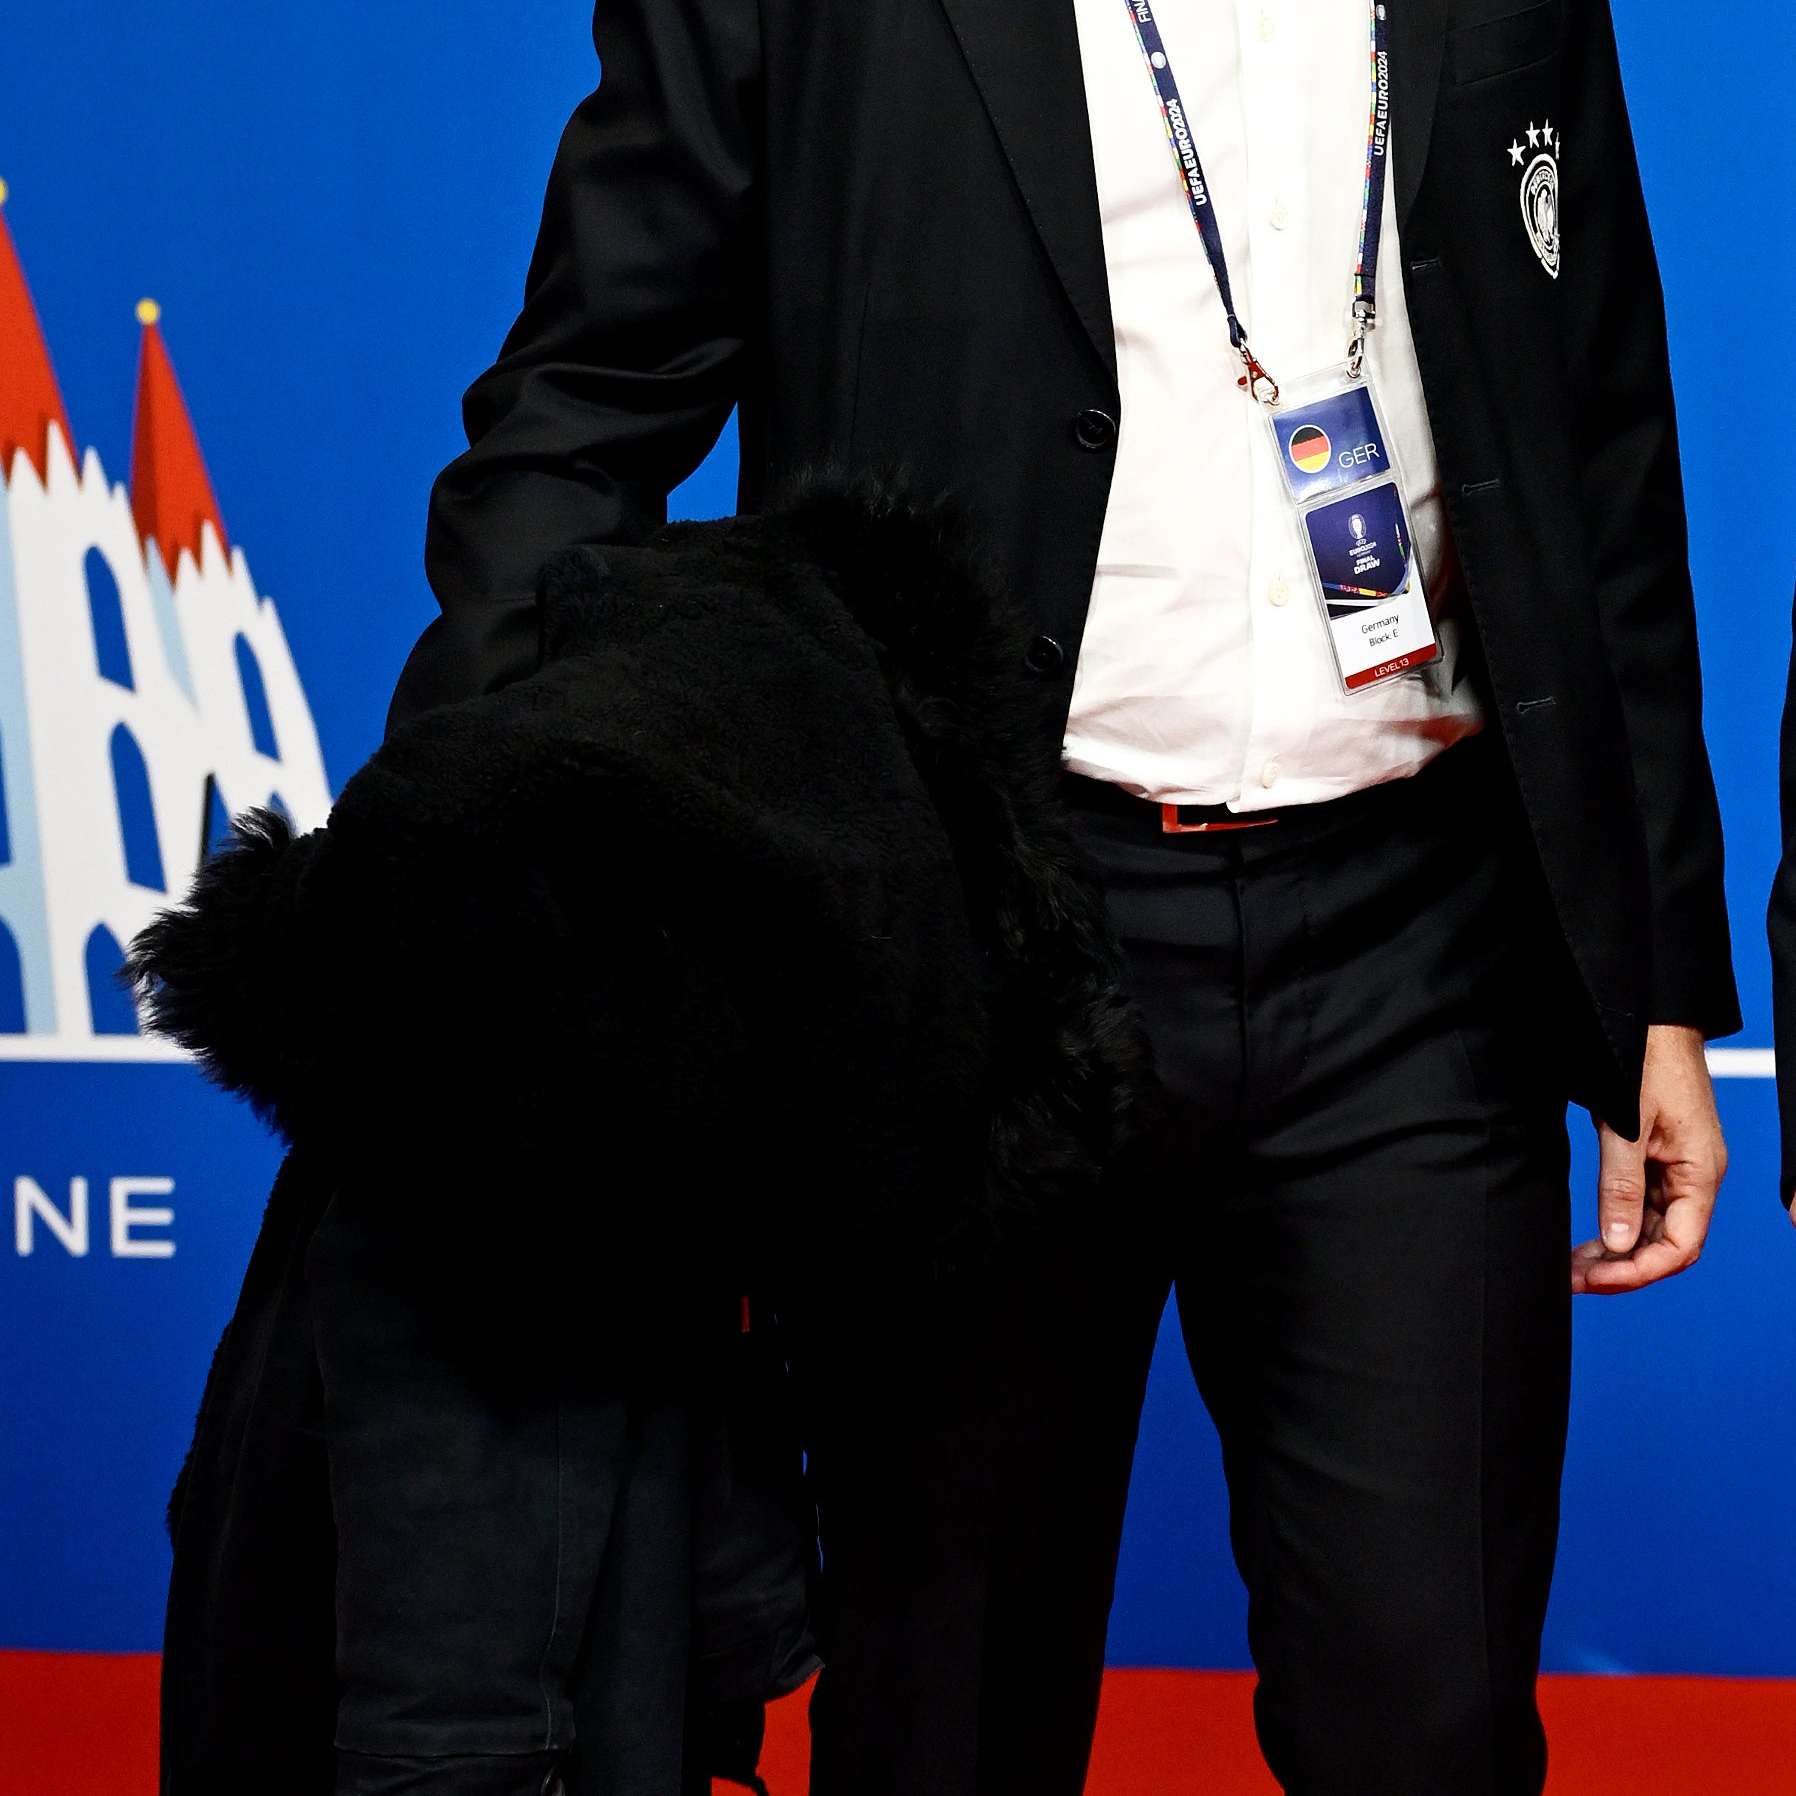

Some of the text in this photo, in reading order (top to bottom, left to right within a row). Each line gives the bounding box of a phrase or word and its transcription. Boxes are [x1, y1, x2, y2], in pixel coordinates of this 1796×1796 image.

[1338, 442, 1380, 470] GER
[1353, 558, 1381, 575] DRAW
[1356, 555, 1376, 566] FINAL
[1361, 614, 1400, 634] Germany
[1369, 628, 1399, 647] Block: E
[1374, 657, 1410, 677] LEVEL 13
[14, 1176, 176, 1258] NE
